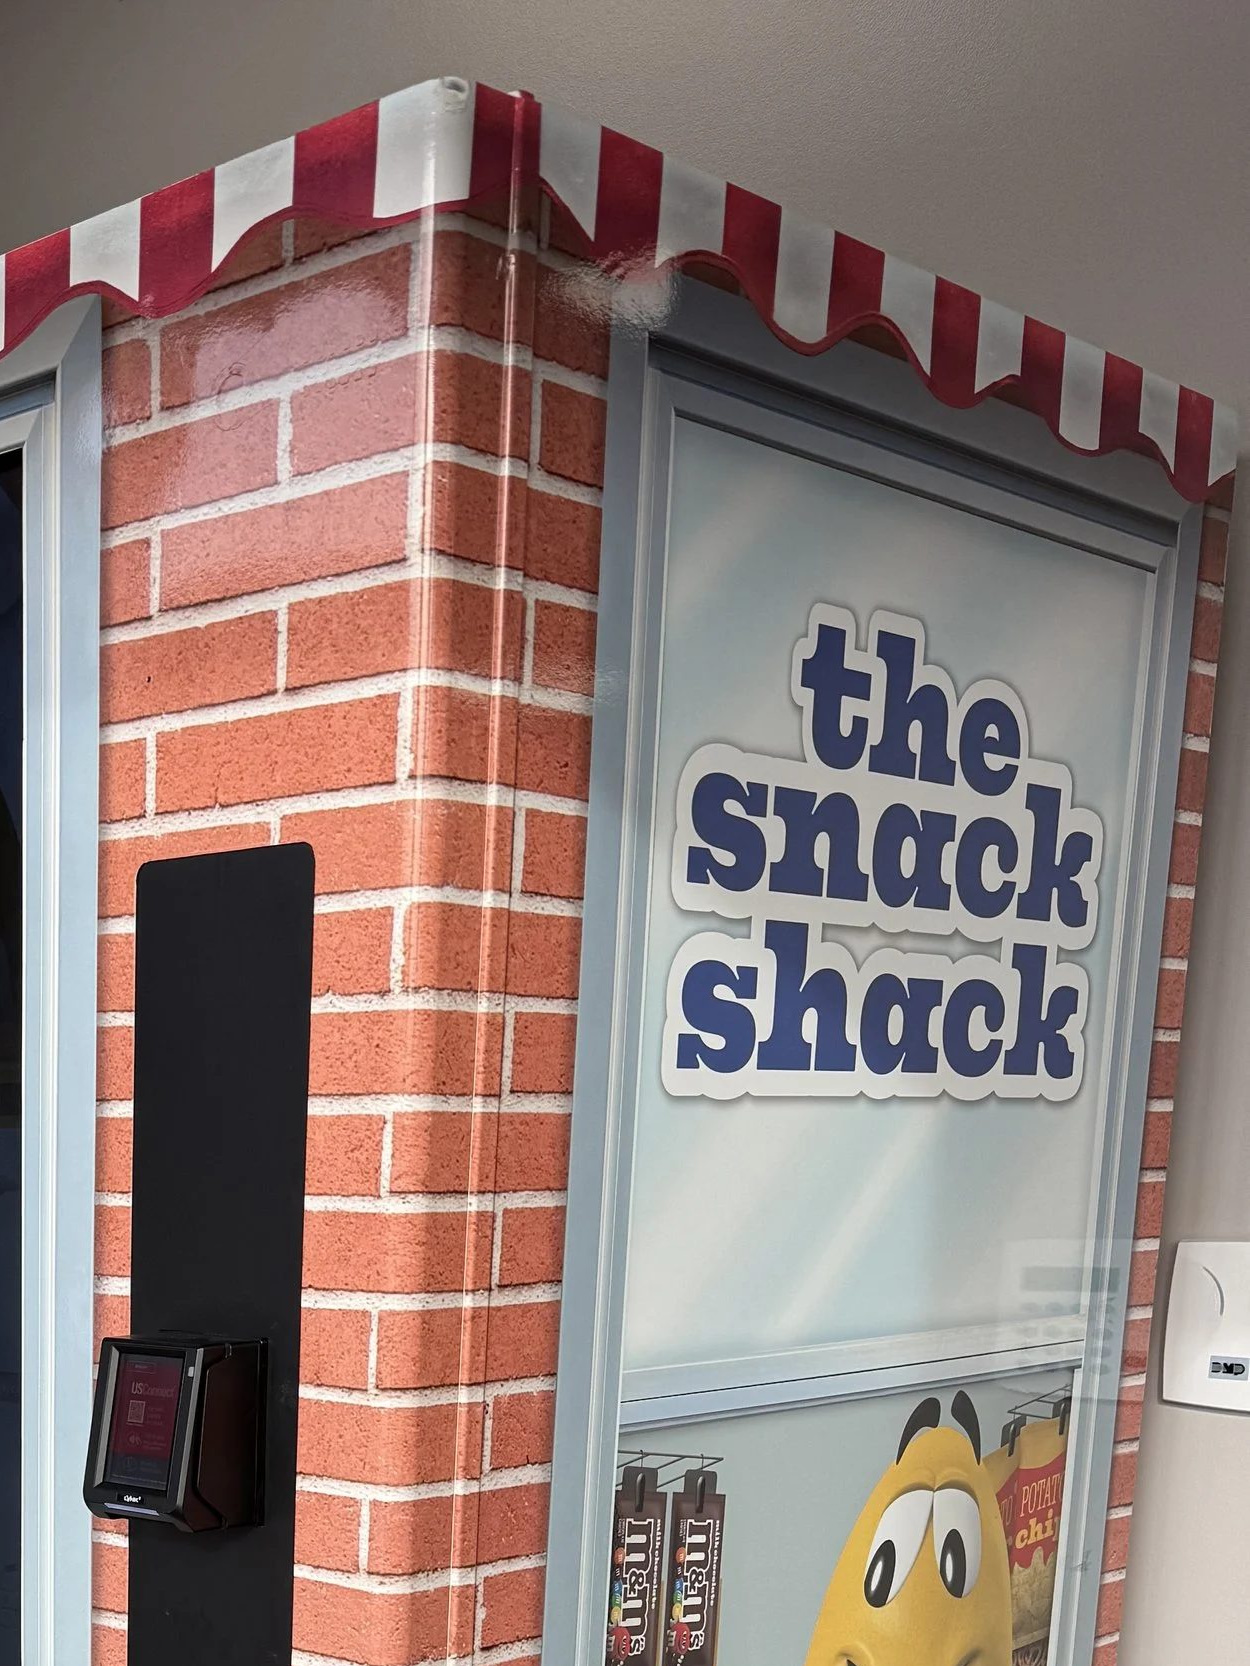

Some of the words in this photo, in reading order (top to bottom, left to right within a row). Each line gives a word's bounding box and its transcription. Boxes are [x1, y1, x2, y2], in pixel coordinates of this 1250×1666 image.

[801, 623, 1021, 797] the
[686, 771, 1094, 928] snack
[676, 919, 1079, 1080] shack
